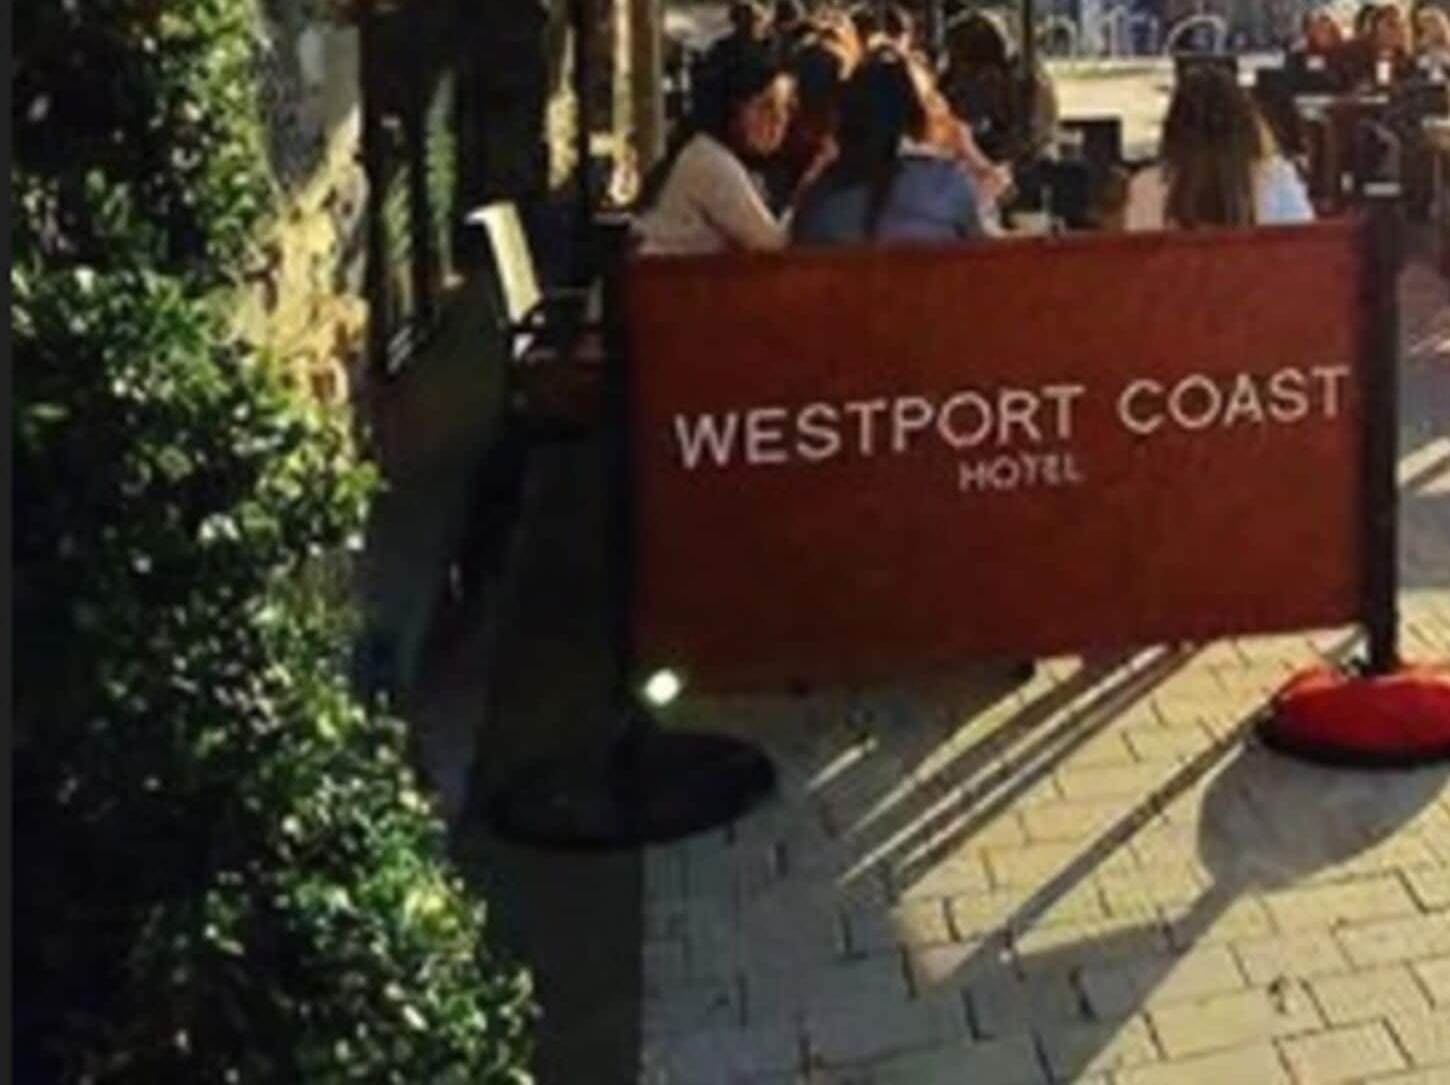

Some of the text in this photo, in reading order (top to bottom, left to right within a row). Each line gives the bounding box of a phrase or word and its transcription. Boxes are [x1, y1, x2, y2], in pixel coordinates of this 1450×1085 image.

[675, 365, 1350, 469] WESTPORT COAST
[957, 451, 1084, 492] HOTEL
